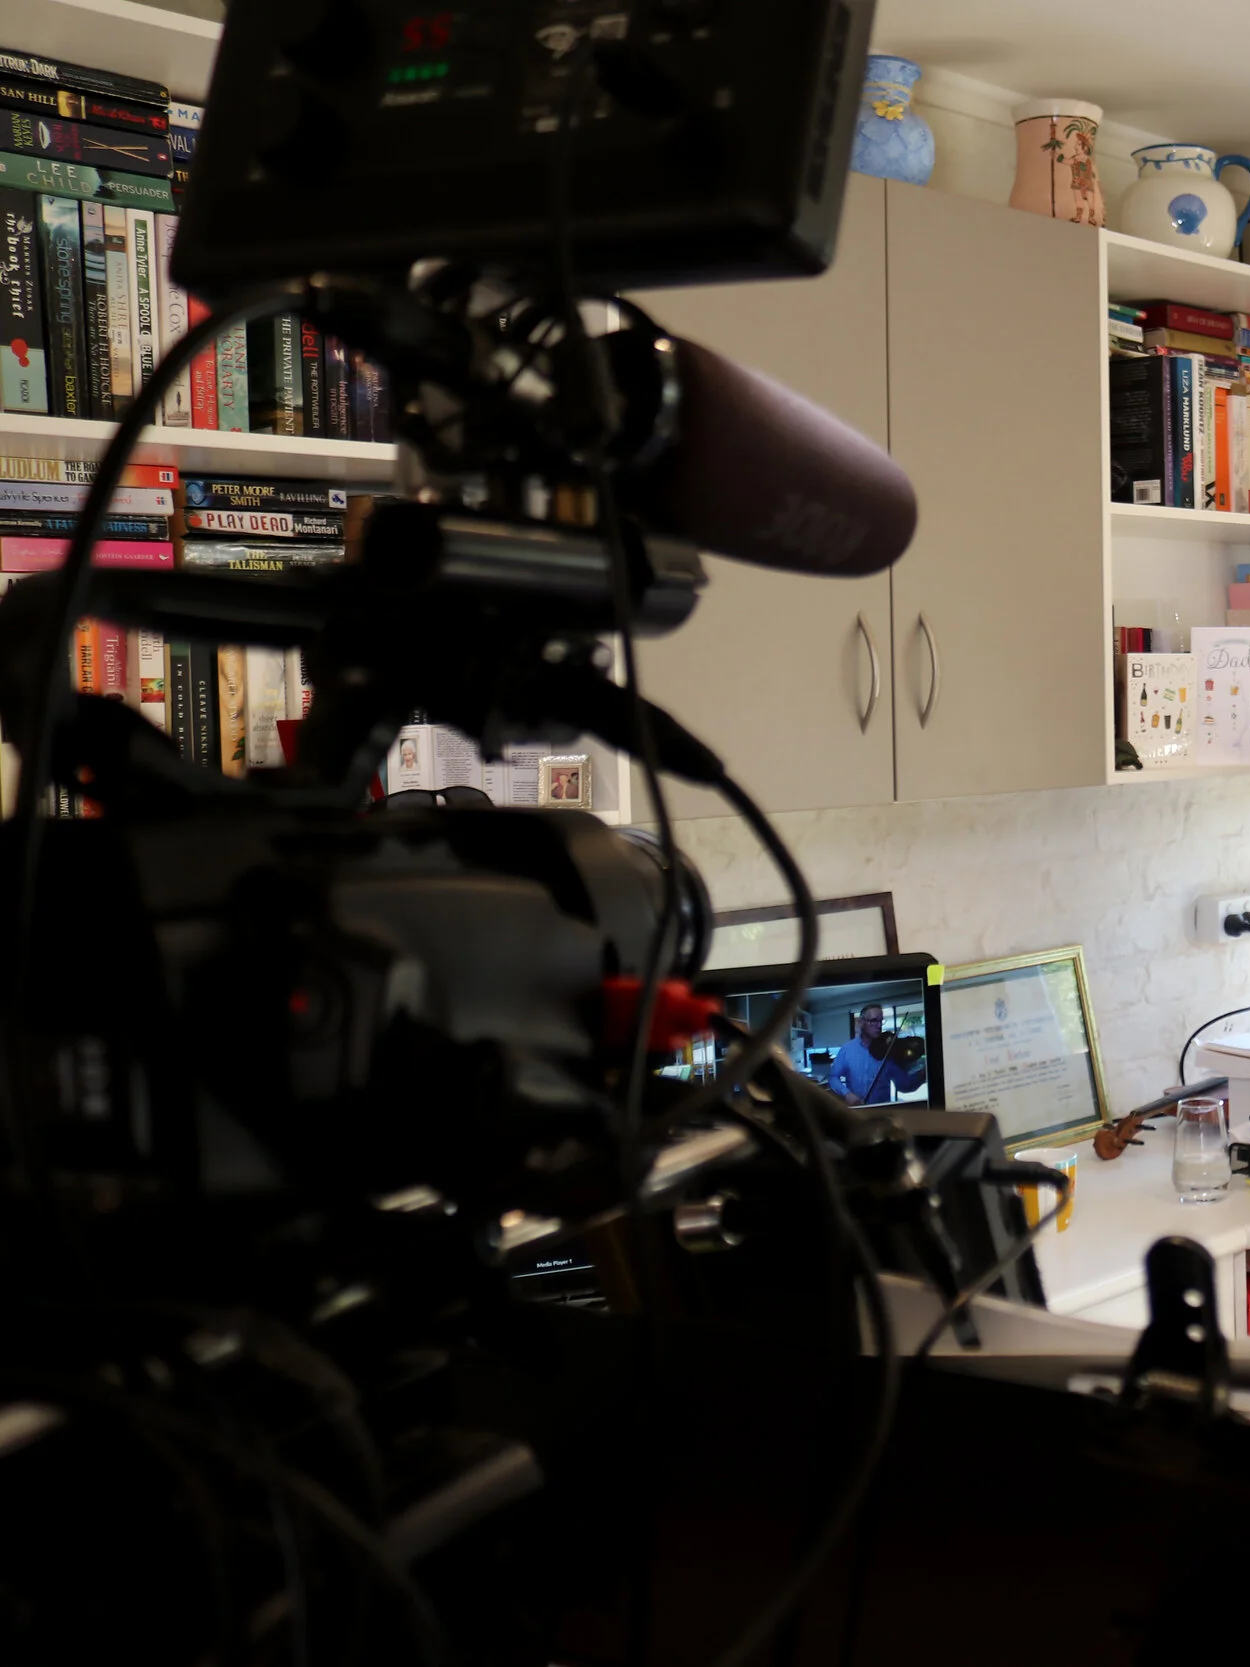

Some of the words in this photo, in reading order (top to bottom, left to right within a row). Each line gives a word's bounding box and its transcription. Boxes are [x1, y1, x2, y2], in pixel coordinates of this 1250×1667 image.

[28, 92, 57, 106] HILL
[12, 113, 25, 149] MARIAN
[22, 119, 34, 147] KEYES
[36, 159, 77, 178] LEE
[26, 172, 92, 194] CHILD
[108, 180, 169, 200] PERSUADER
[135, 227, 147, 252] Anne
[7, 236, 21, 272] book
[55, 238, 73, 277] stone
[136, 253, 149, 279] Tyler
[10, 280, 25, 320] thief
[53, 279, 75, 324] spring
[139, 297, 151, 328] SPOOL
[96, 293, 109, 339] ROBERT
[168, 302, 185, 334] Cox
[141, 345, 153, 370] BLUE
[281, 337, 293, 384] PRIVATE
[310, 362, 319, 378] THE
[63, 374, 78, 416] baxter
[100, 357, 113, 407] HOPCKE
[1181, 369, 1190, 394] LIZA
[283, 386, 295, 434] PATIENT
[310, 380, 320, 430] ROTTWEILER
[1182, 396, 1191, 452] MARKLUND
[0, 456, 60, 481] LUDLUM
[65, 461, 81, 474] THE
[65, 472, 76, 483] TO
[212, 484, 240, 495] PETER
[243, 485, 276, 497] MOORE
[230, 495, 261, 507] SMITH
[206, 513, 245, 530] PLAY
[249, 515, 289, 533] DEAD
[294, 522, 340, 535] Montanari
[228, 560, 284, 572] TALISMAN
[246, 549, 267, 560] THE
[81, 645, 93, 682] HARLAN
[104, 635, 120, 687] Trigiani
[199, 680, 208, 720] CLEAVE
[200, 725, 208, 755] NIKKI
